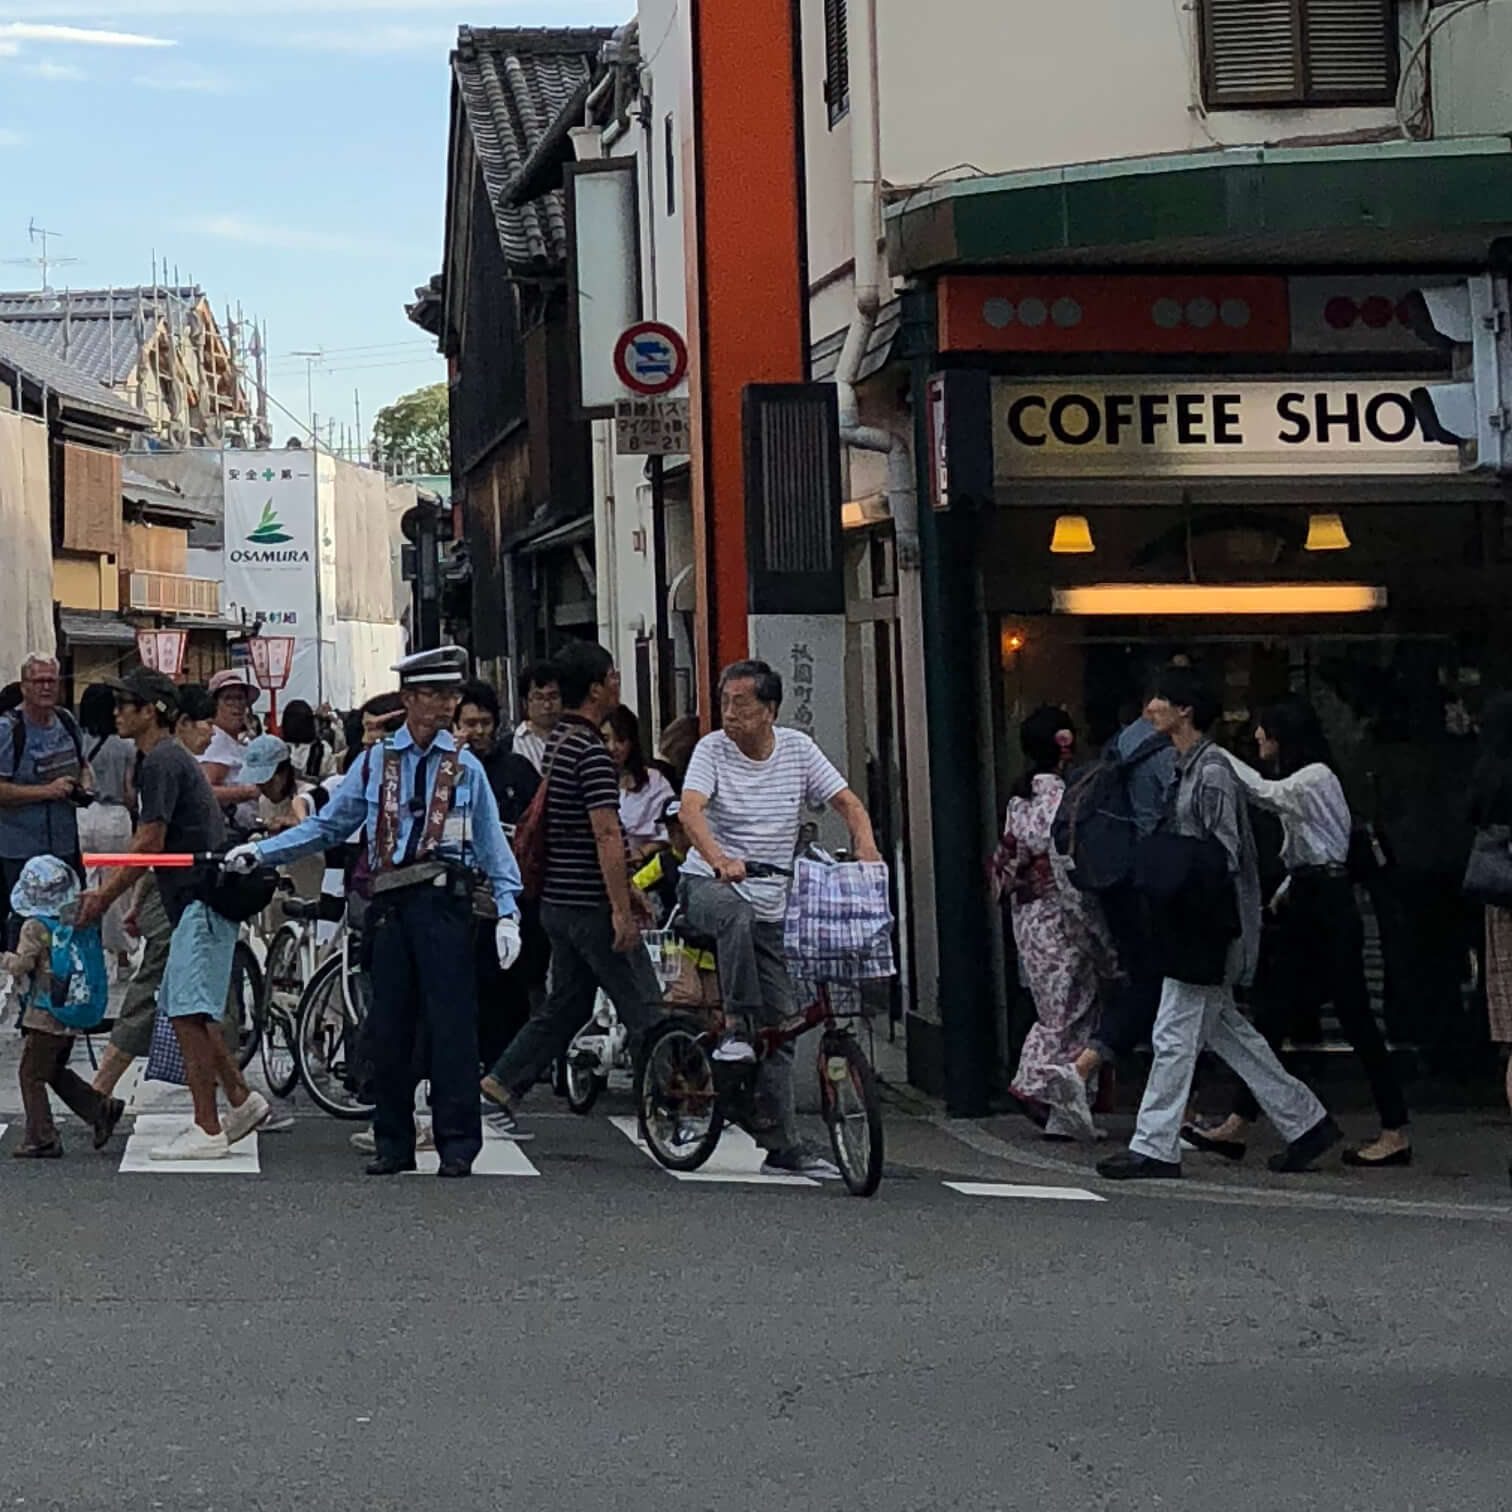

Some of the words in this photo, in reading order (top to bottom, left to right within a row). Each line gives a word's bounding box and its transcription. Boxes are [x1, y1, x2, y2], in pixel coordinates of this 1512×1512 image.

[1007, 394, 1243, 446] COFFEE
[1277, 392, 1437, 444] SHO
[230, 550, 309, 563] OSAMURA
